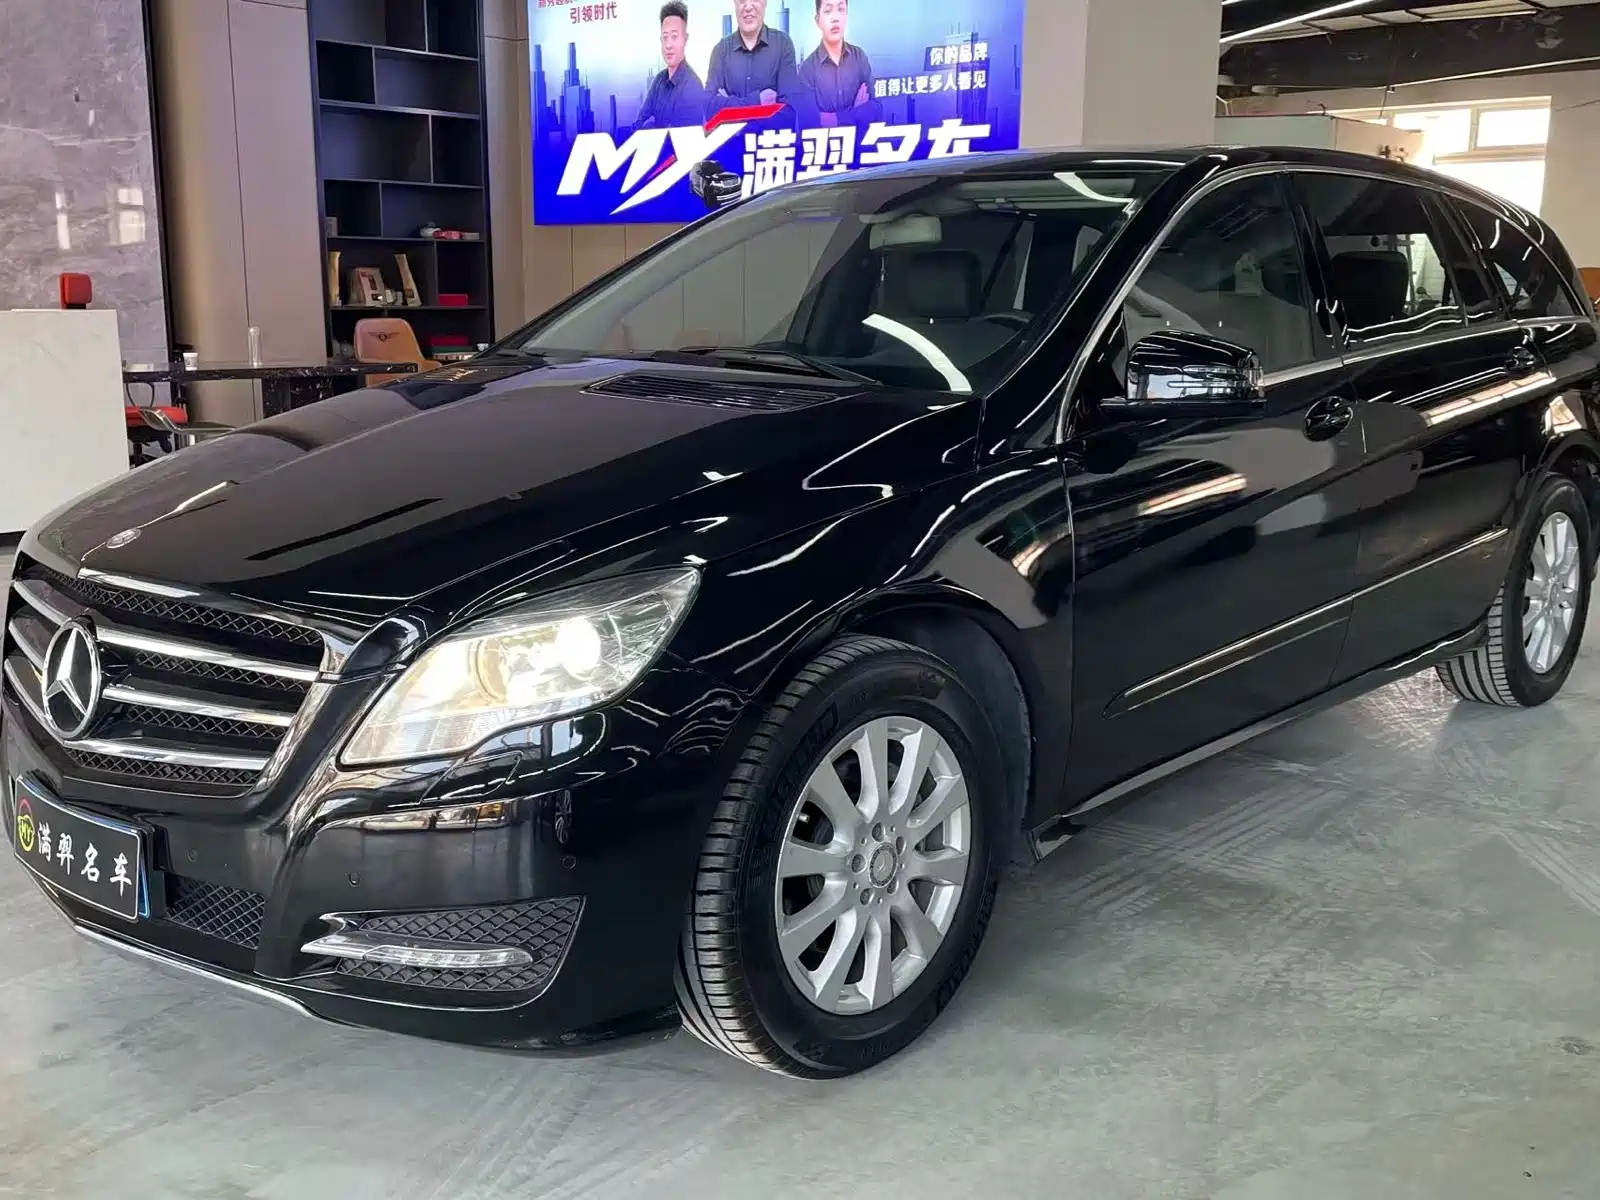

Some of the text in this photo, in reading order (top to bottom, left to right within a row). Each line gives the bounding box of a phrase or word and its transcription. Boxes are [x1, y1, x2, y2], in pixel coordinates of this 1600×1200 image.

[570, 2, 617, 24] 引领时代
[930, 42, 988, 66] 你的品牌
[874, 70, 987, 98] 值得让更多人看见
